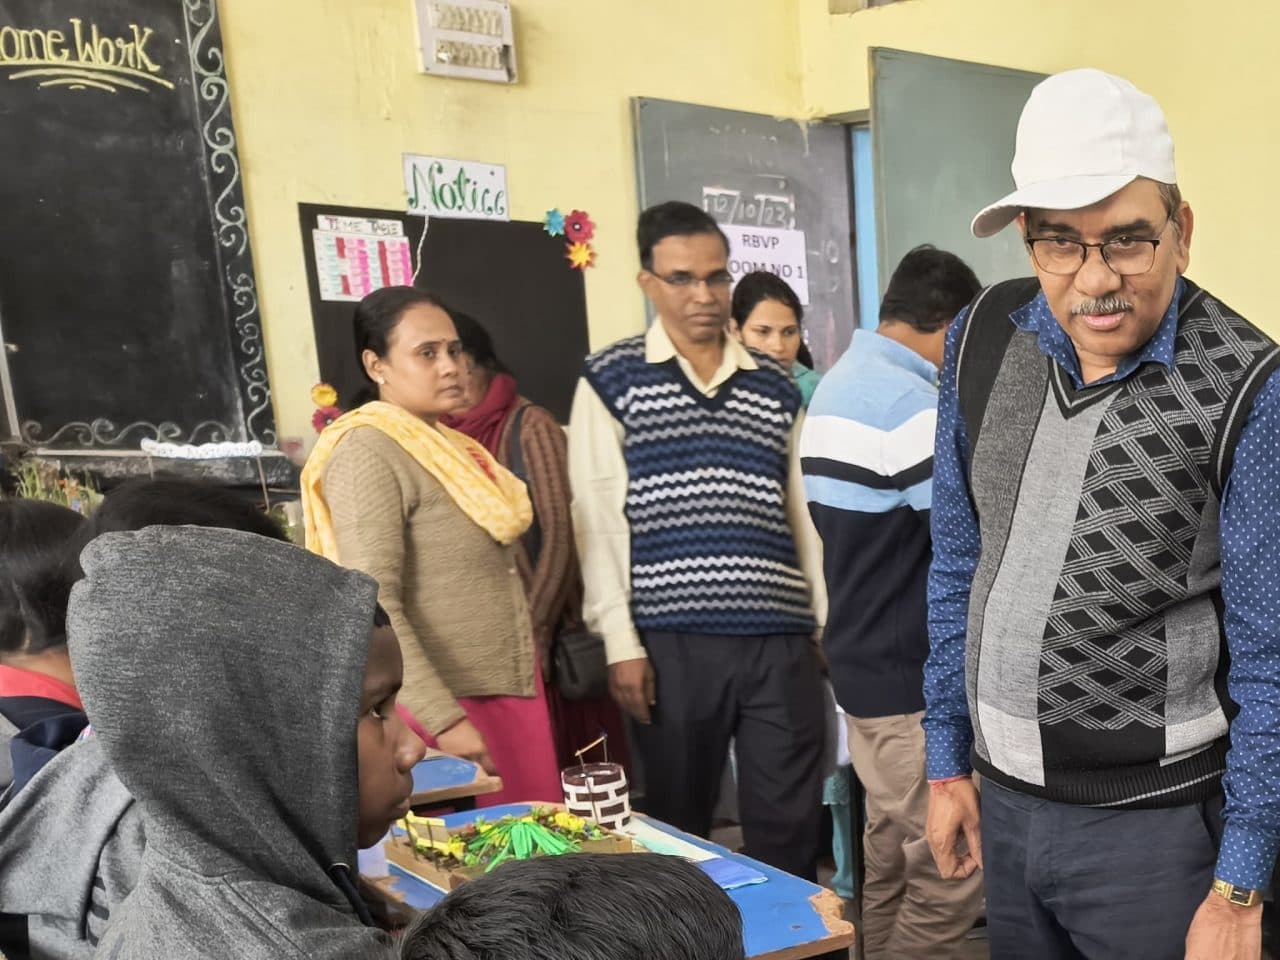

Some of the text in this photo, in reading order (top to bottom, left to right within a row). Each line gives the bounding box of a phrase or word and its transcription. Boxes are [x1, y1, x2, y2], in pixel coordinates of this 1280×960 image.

[0, 26, 69, 63] ome
[408, 161, 505, 215] Notice
[742, 233, 779, 250] RBVP
[729, 259, 804, 280] OOM NO 1
